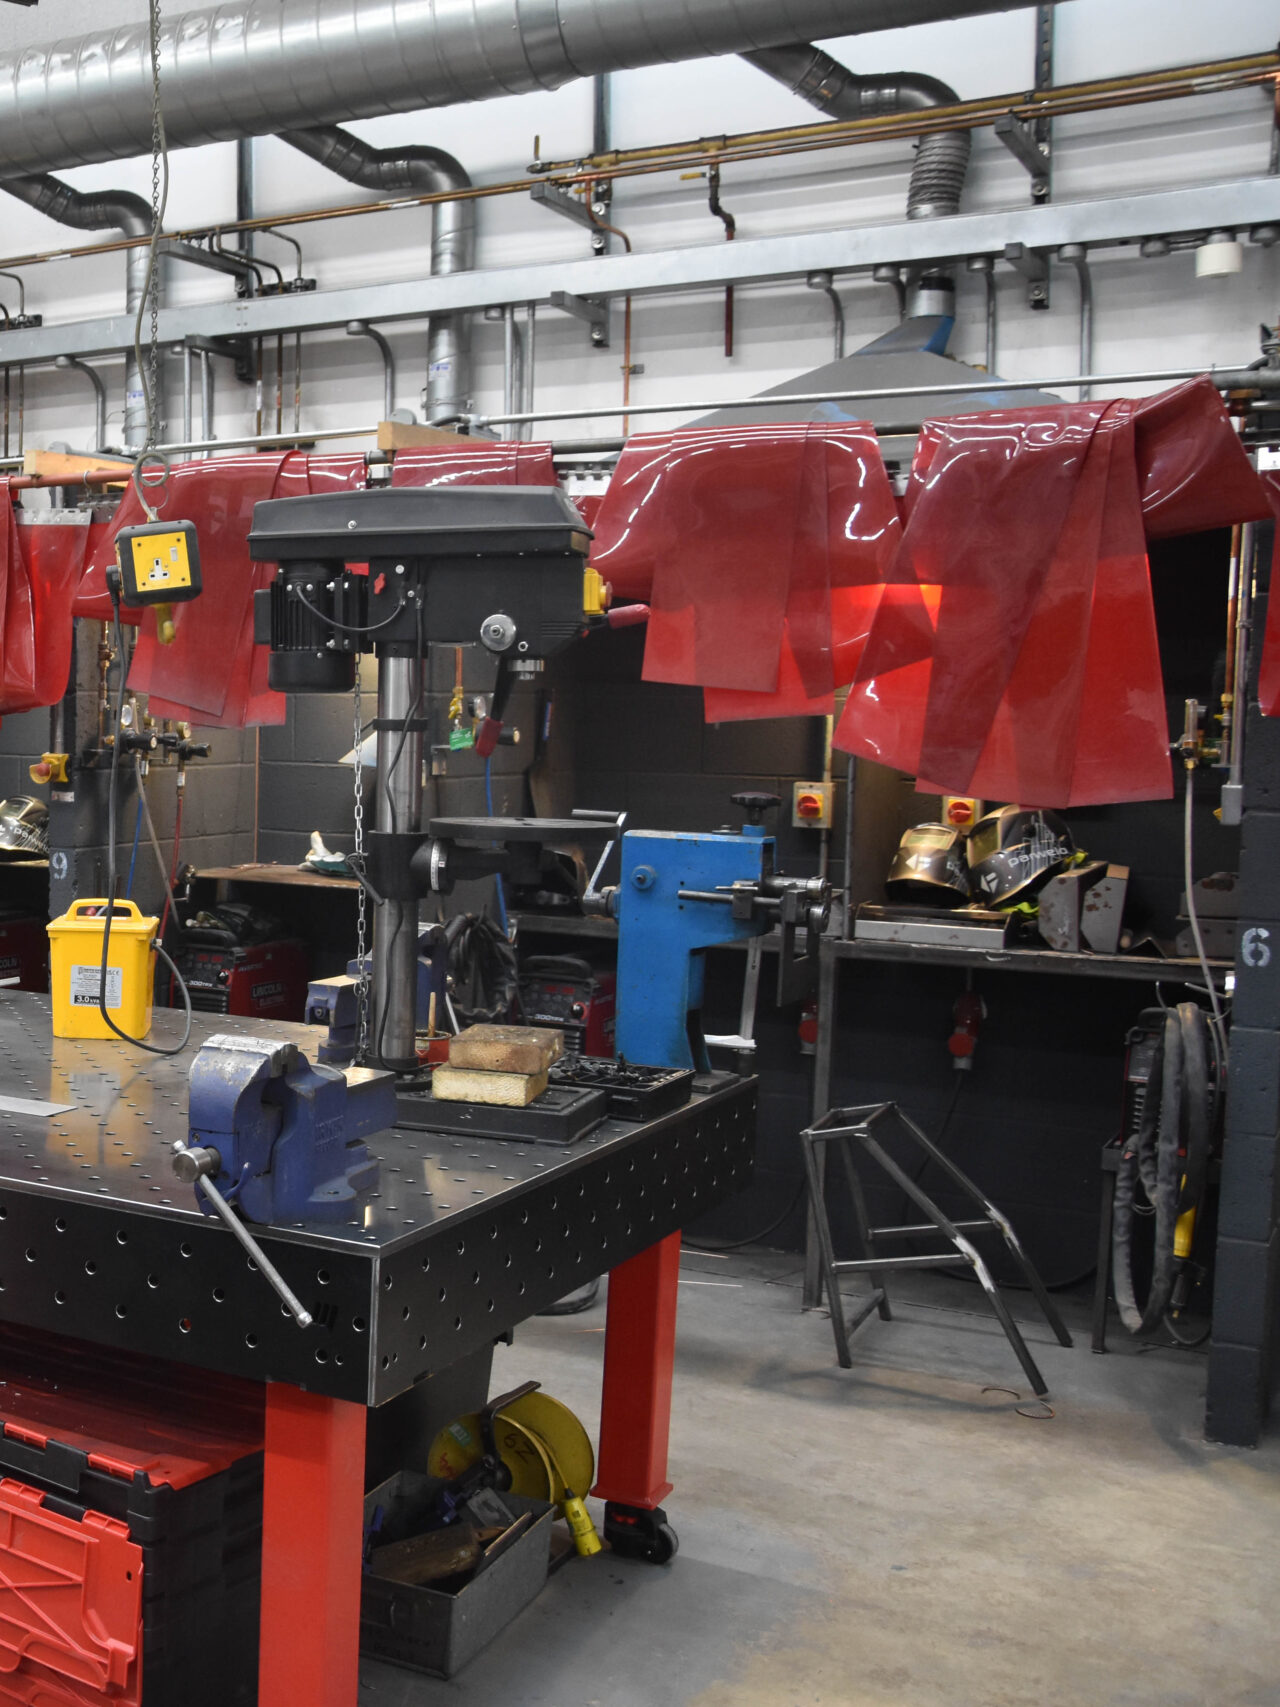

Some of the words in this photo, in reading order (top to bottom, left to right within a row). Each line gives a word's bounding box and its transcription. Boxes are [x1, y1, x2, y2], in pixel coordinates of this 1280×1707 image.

[52, 851, 67, 880] 9
[1242, 927, 1270, 967] 6
[76, 995, 90, 1003] 3.0
